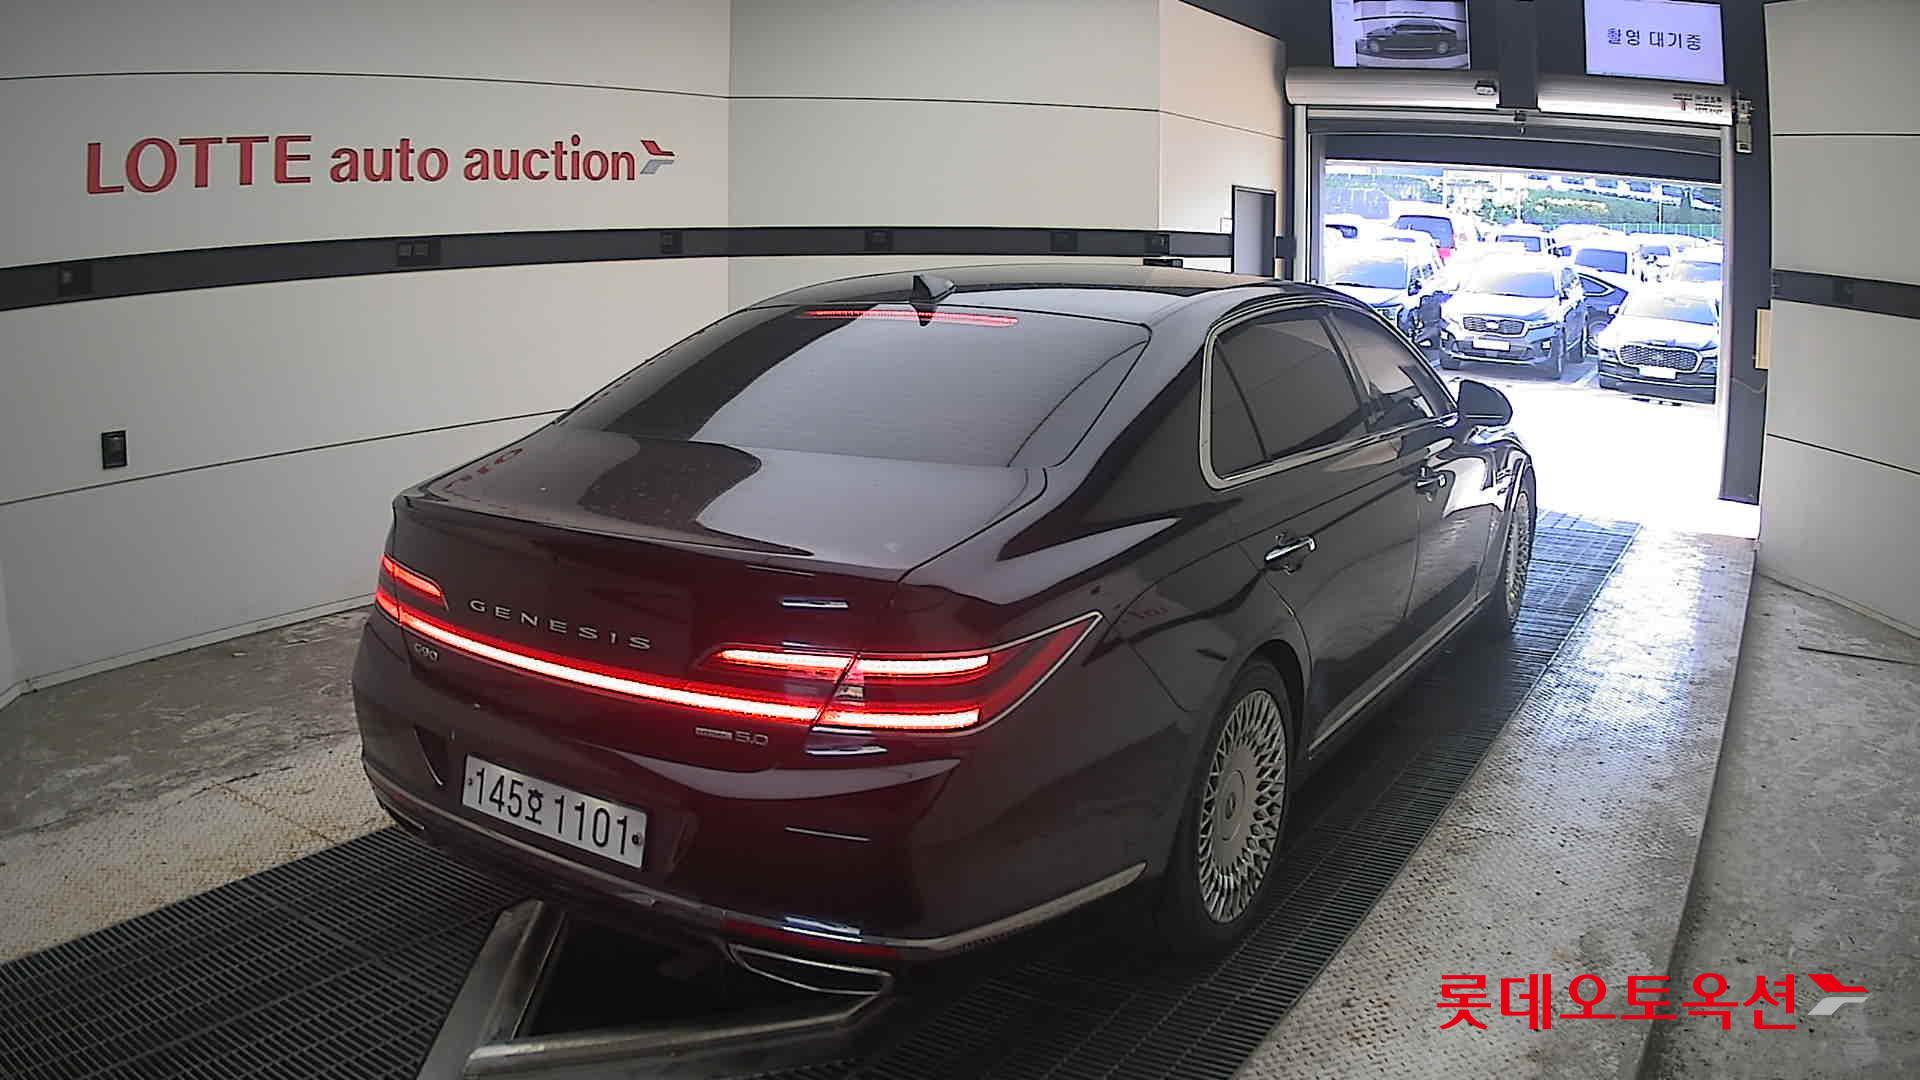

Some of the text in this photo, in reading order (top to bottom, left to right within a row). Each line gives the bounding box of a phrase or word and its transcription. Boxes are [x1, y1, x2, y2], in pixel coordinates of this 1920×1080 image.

[1649, 30, 1702, 51] 대기중
[86, 134, 635, 194] LOTTE auto auction
[470, 600, 650, 650] GENESIS
